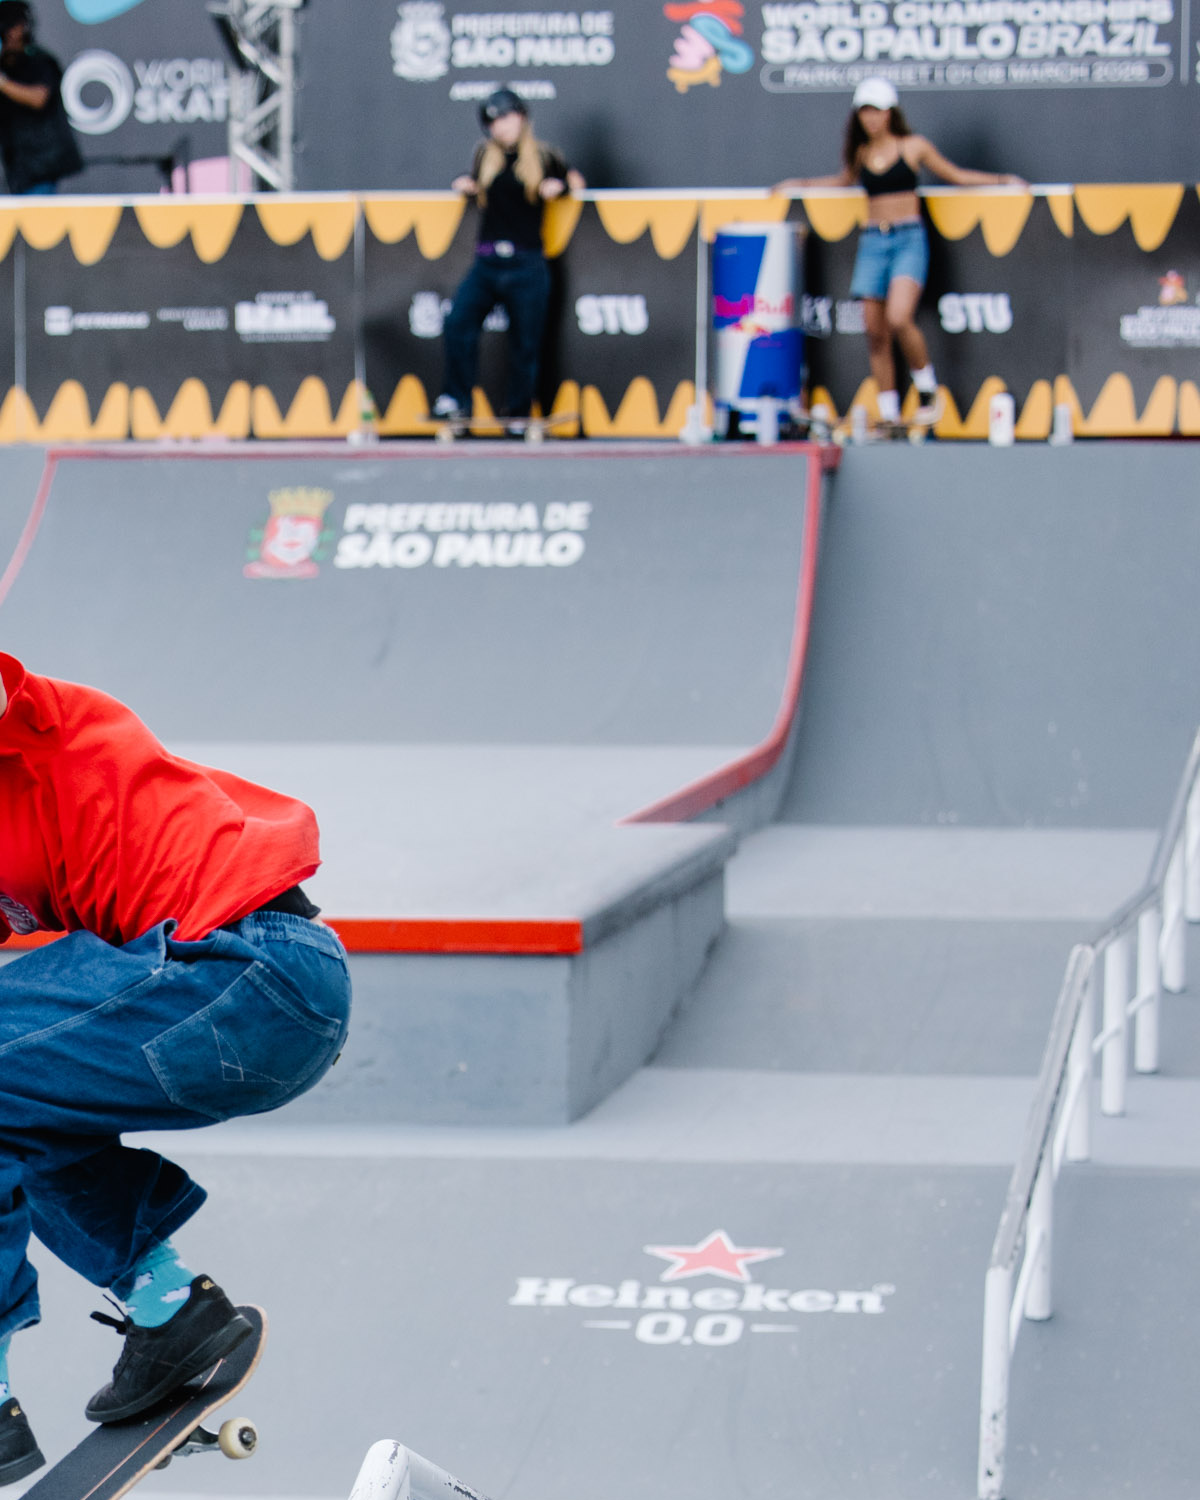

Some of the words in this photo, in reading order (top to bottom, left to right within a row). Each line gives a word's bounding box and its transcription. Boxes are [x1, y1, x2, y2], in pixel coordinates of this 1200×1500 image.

[761, 3, 889, 28] WORLD
[451, 35, 515, 67] SÃO
[514, 35, 615, 66] PAULO
[761, 25, 863, 63] SÃO
[862, 24, 1016, 61] PAULO
[1016, 23, 1172, 58] BRAZIL
[133, 57, 226, 91] WORL
[133, 86, 230, 123] SKAT
[576, 294, 648, 335] STU
[939, 293, 1013, 333] STU
[343, 502, 541, 530] PREFEITURA
[544, 501, 593, 530] DE
[334, 530, 433, 568] SÃO
[434, 530, 586, 568] PAULO
[509, 1277, 884, 1314] Heineken
[634, 1311, 744, 1346] 0.0
